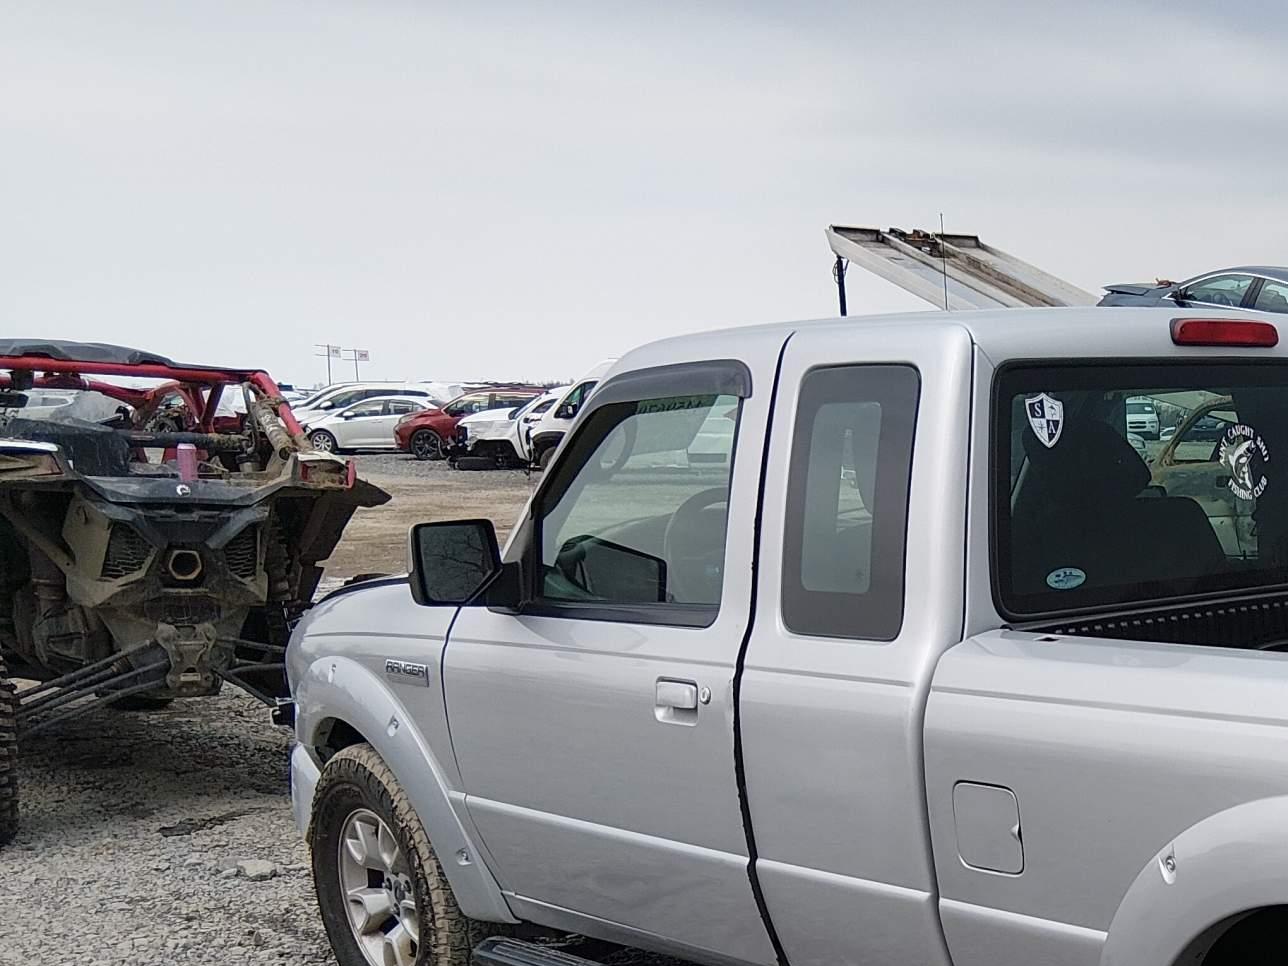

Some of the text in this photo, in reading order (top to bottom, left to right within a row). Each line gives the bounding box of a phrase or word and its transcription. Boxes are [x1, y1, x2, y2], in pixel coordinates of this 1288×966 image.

[1034, 402, 1042, 417] S
[1048, 420, 1056, 434] A
[1227, 424, 1255, 439] CAUGHT
[1228, 475, 1268, 500] FISHING CLUB
[386, 660, 426, 678] RANGER
